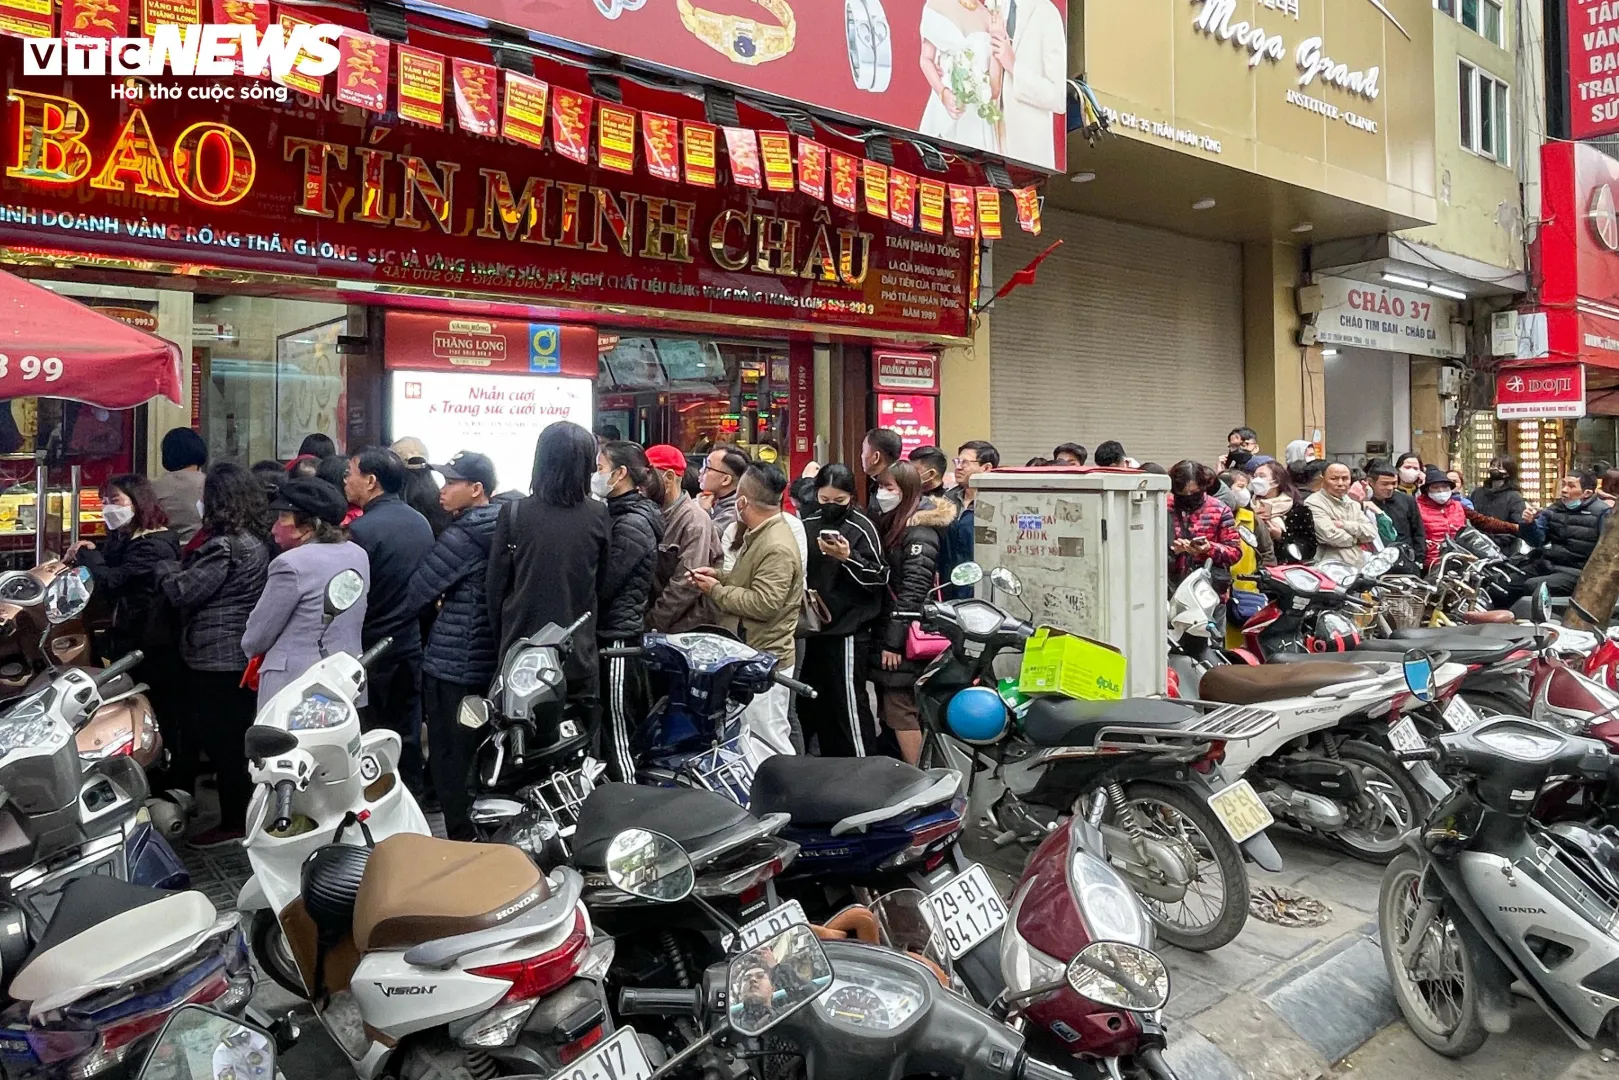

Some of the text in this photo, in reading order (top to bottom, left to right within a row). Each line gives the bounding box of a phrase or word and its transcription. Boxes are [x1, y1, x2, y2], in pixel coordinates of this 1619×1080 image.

[1192, 0, 1380, 99] Mega Grand
[1590, 52, 1619, 74] BẠ
[1285, 88, 1339, 120] INSTITUTE
[1345, 110, 1379, 133] CLINIC
[1140, 118, 1150, 132] 35
[1176, 129, 1199, 147] NHÂN
[1200, 135, 1222, 153] TÔNG
[283, 127, 461, 235] TÍN
[478, 167, 696, 264] MINH
[709, 204, 875, 286] CHÂU
[42, 209, 119, 234] DOANH
[125, 216, 179, 240] VÀNG
[1347, 289, 1431, 322] CHÁO 37
[1340, 314, 1363, 330] CHÁO
[1365, 319, 1380, 332] TIM
[1381, 321, 1399, 334] GAN
[1405, 323, 1425, 339] CHÁO
[436, 336, 504, 351] THĂNG LONG
[1528, 378, 1571, 396] DOJI
[442, 400, 480, 416] Trang
[540, 404, 571, 419] vàng
[798, 396, 807, 431] BTMC
[1294, 704, 1344, 715] VISION
[495, 892, 540, 920] HONDA
[934, 874, 985, 922] 29-B1
[1498, 905, 1547, 915] HONDA
[945, 897, 1005, 951] 841.79
[373, 982, 437, 997] VISION
